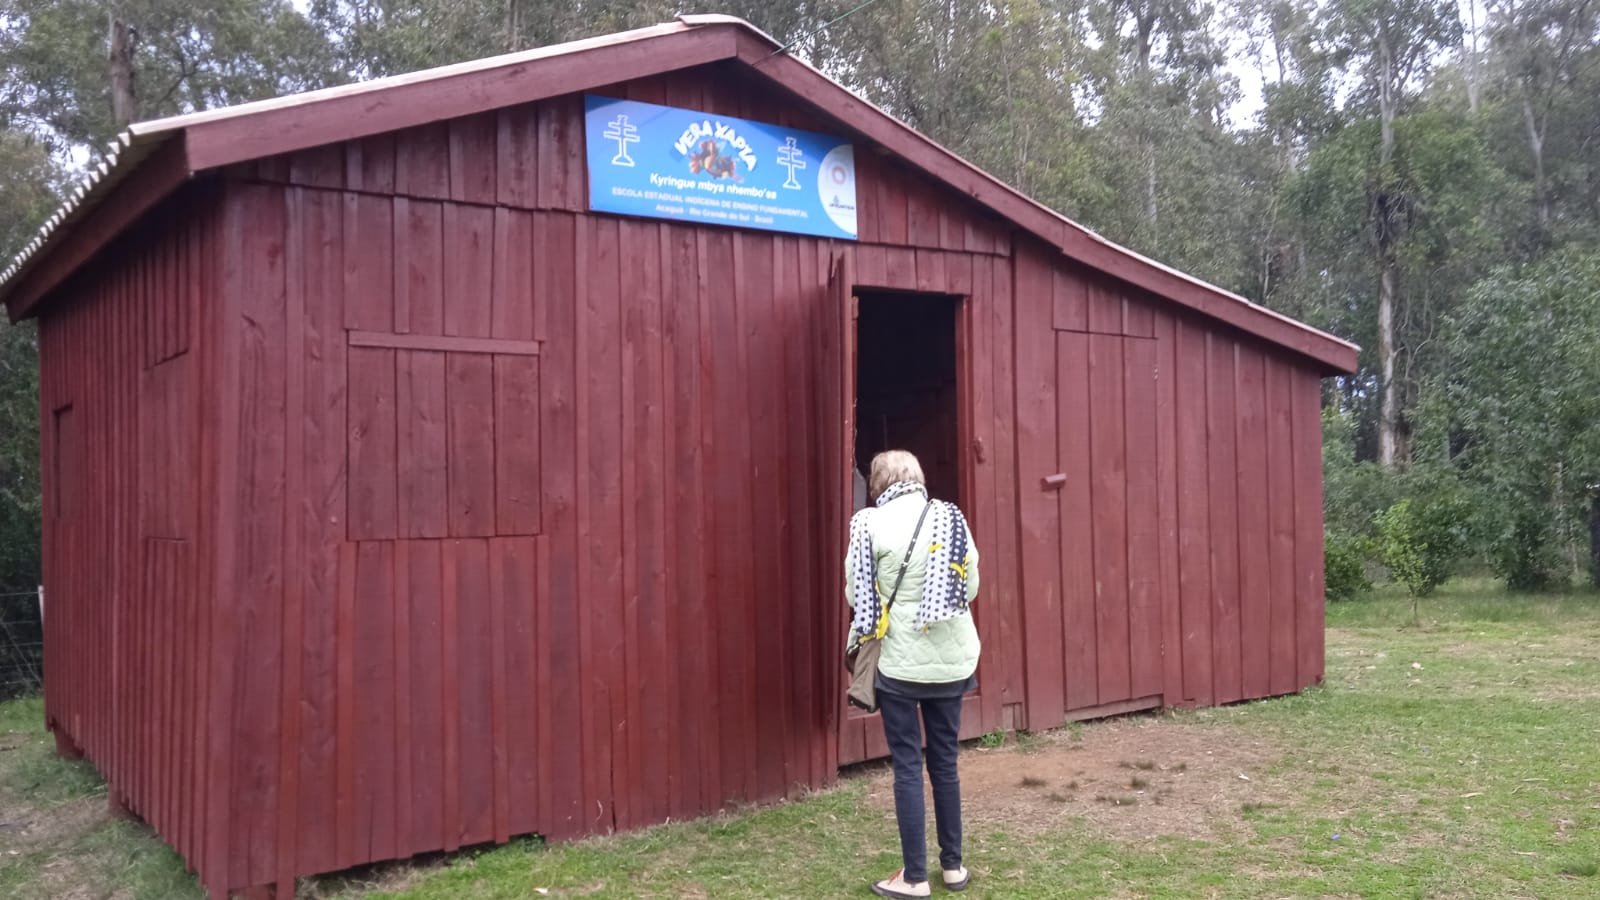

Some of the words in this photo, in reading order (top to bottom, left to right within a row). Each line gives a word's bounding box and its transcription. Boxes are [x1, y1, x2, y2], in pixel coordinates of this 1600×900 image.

[674, 120, 713, 156] VERA
[698, 181, 725, 194] mbya
[612, 187, 643, 198] ESCOLA
[644, 191, 683, 202] ESTADUAL
[721, 200, 731, 208] DE
[760, 205, 808, 218] FUNDAMENTAL
[702, 208, 727, 219] Grande
